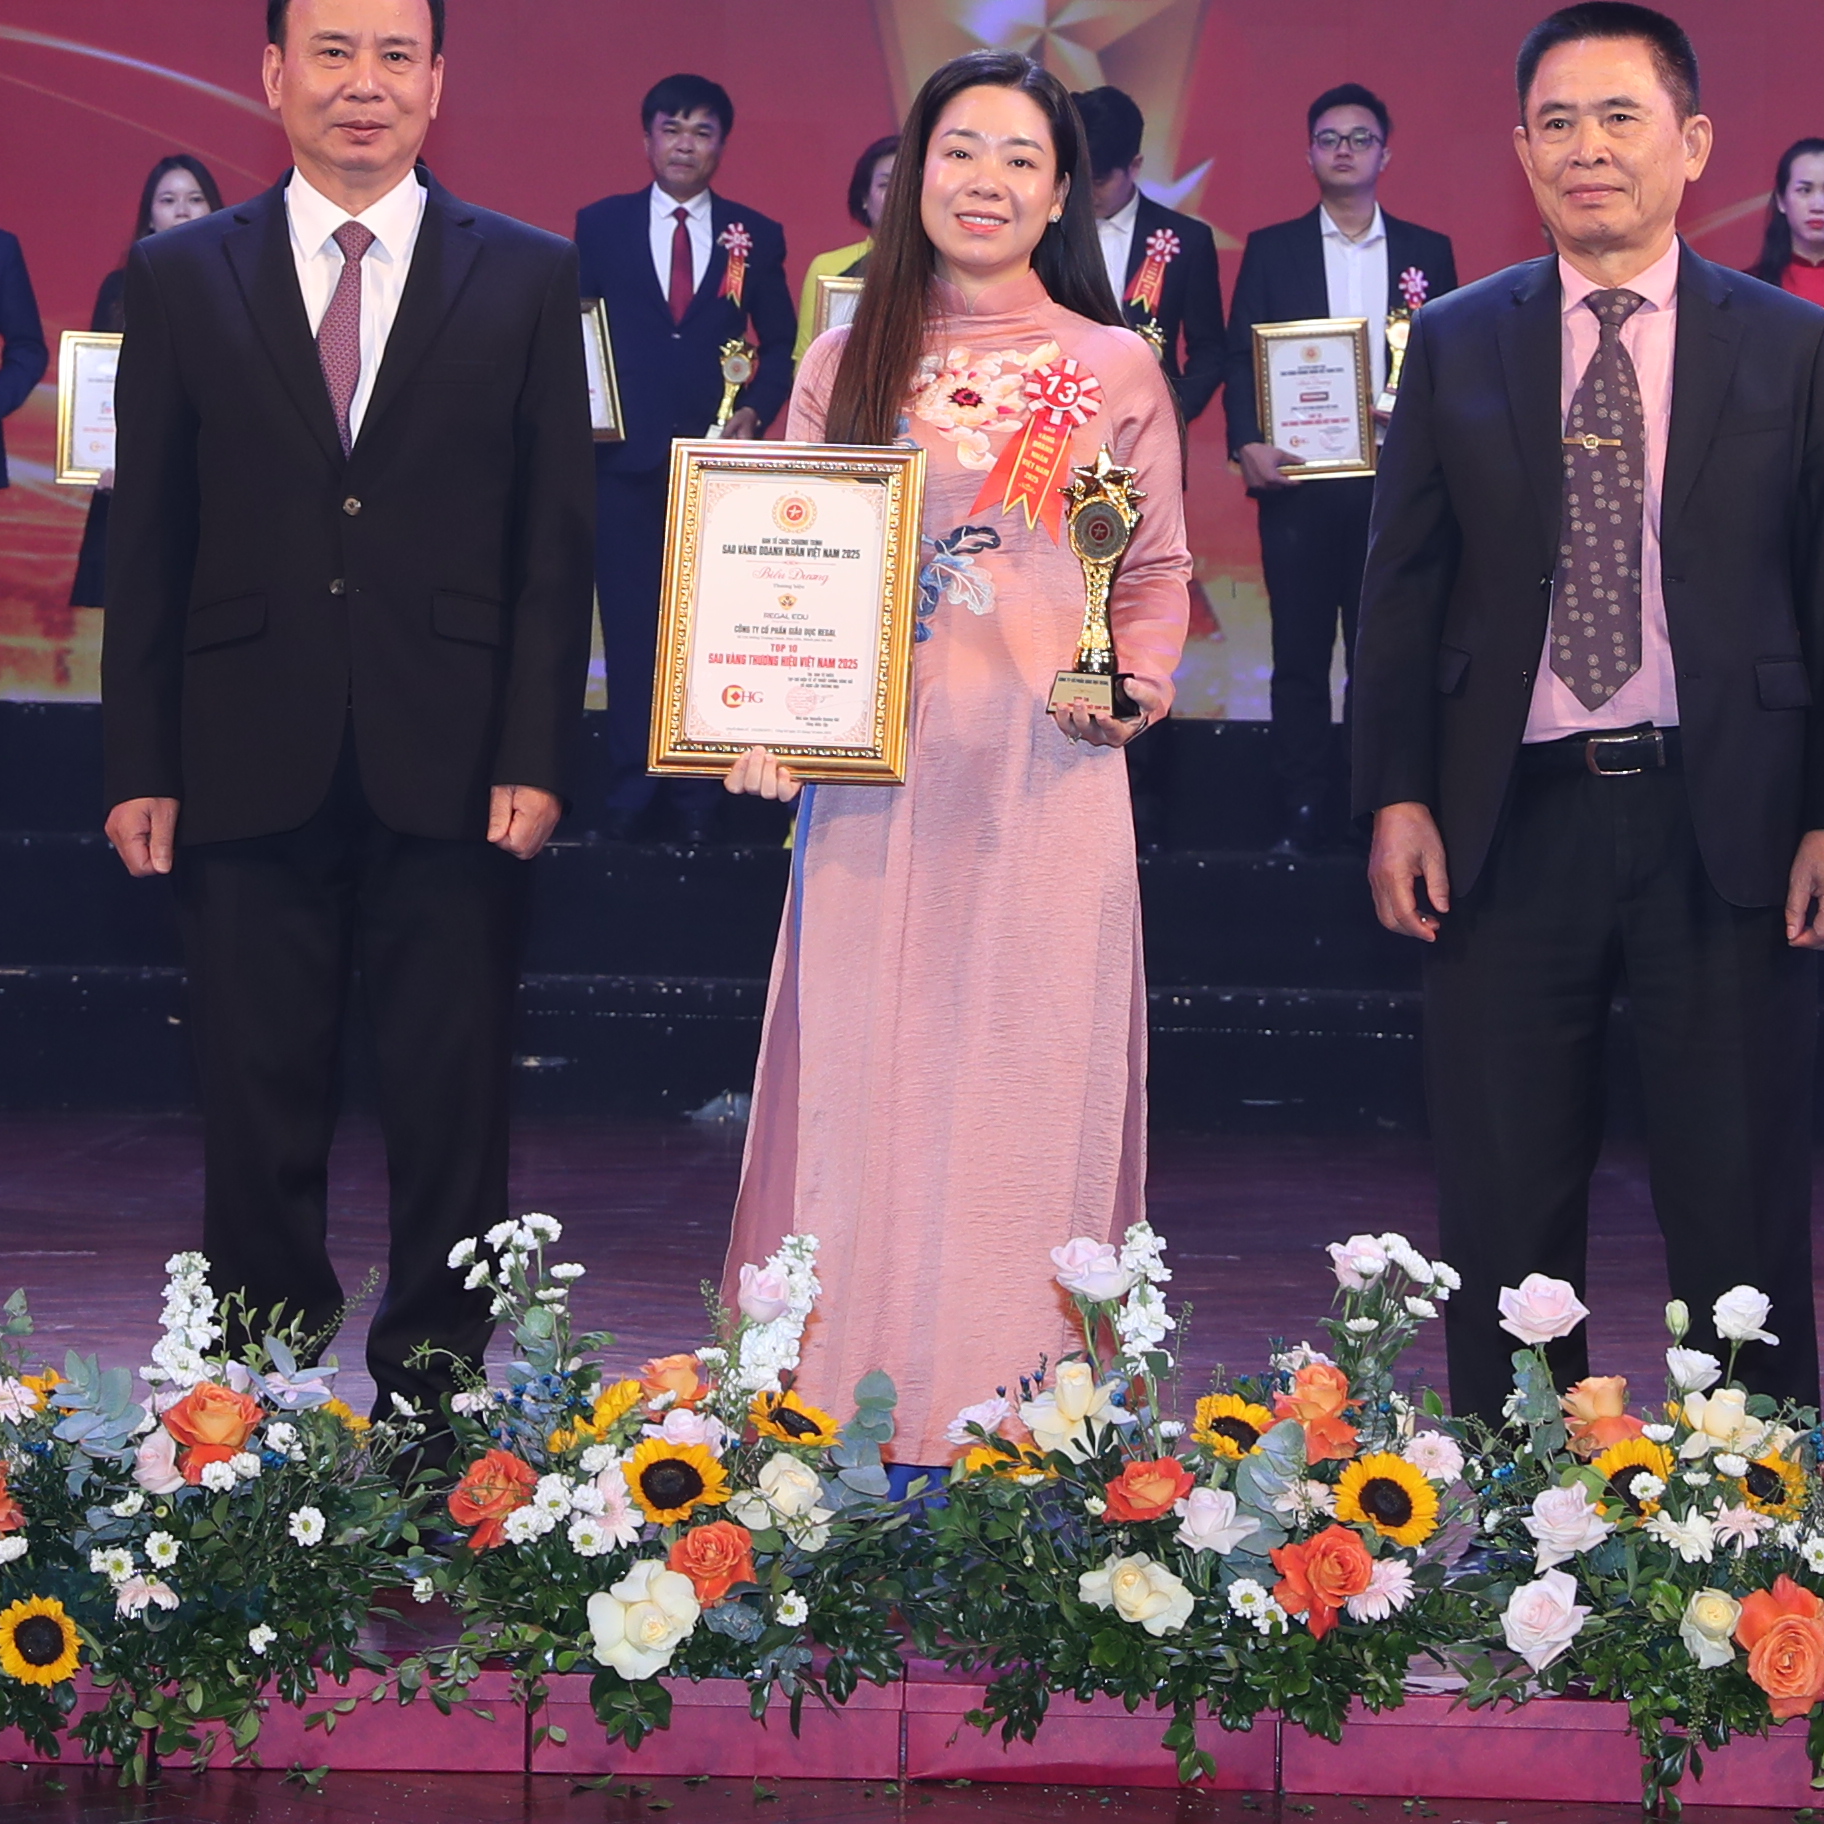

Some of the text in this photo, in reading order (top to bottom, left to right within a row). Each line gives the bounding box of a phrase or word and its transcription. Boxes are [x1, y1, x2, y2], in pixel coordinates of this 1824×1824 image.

[1155, 238, 1172, 254] 01
[1046, 375, 1078, 404] 13
[722, 544, 736, 554] SAO
[738, 543, 758, 555] VÀNG
[759, 545, 783, 557] DOANH
[785, 544, 805, 557] NHÂN
[823, 548, 840, 558] NAM
[841, 549, 861, 559] 2025
[763, 612, 789, 620] REGAL
[752, 625, 759, 634] TY
[770, 643, 798, 653] TOP 10
[708, 653, 723, 664] SAO
[726, 652, 746, 665] VÀNG
[817, 657, 836, 668] NAM
[838, 658, 858, 669] 2025
